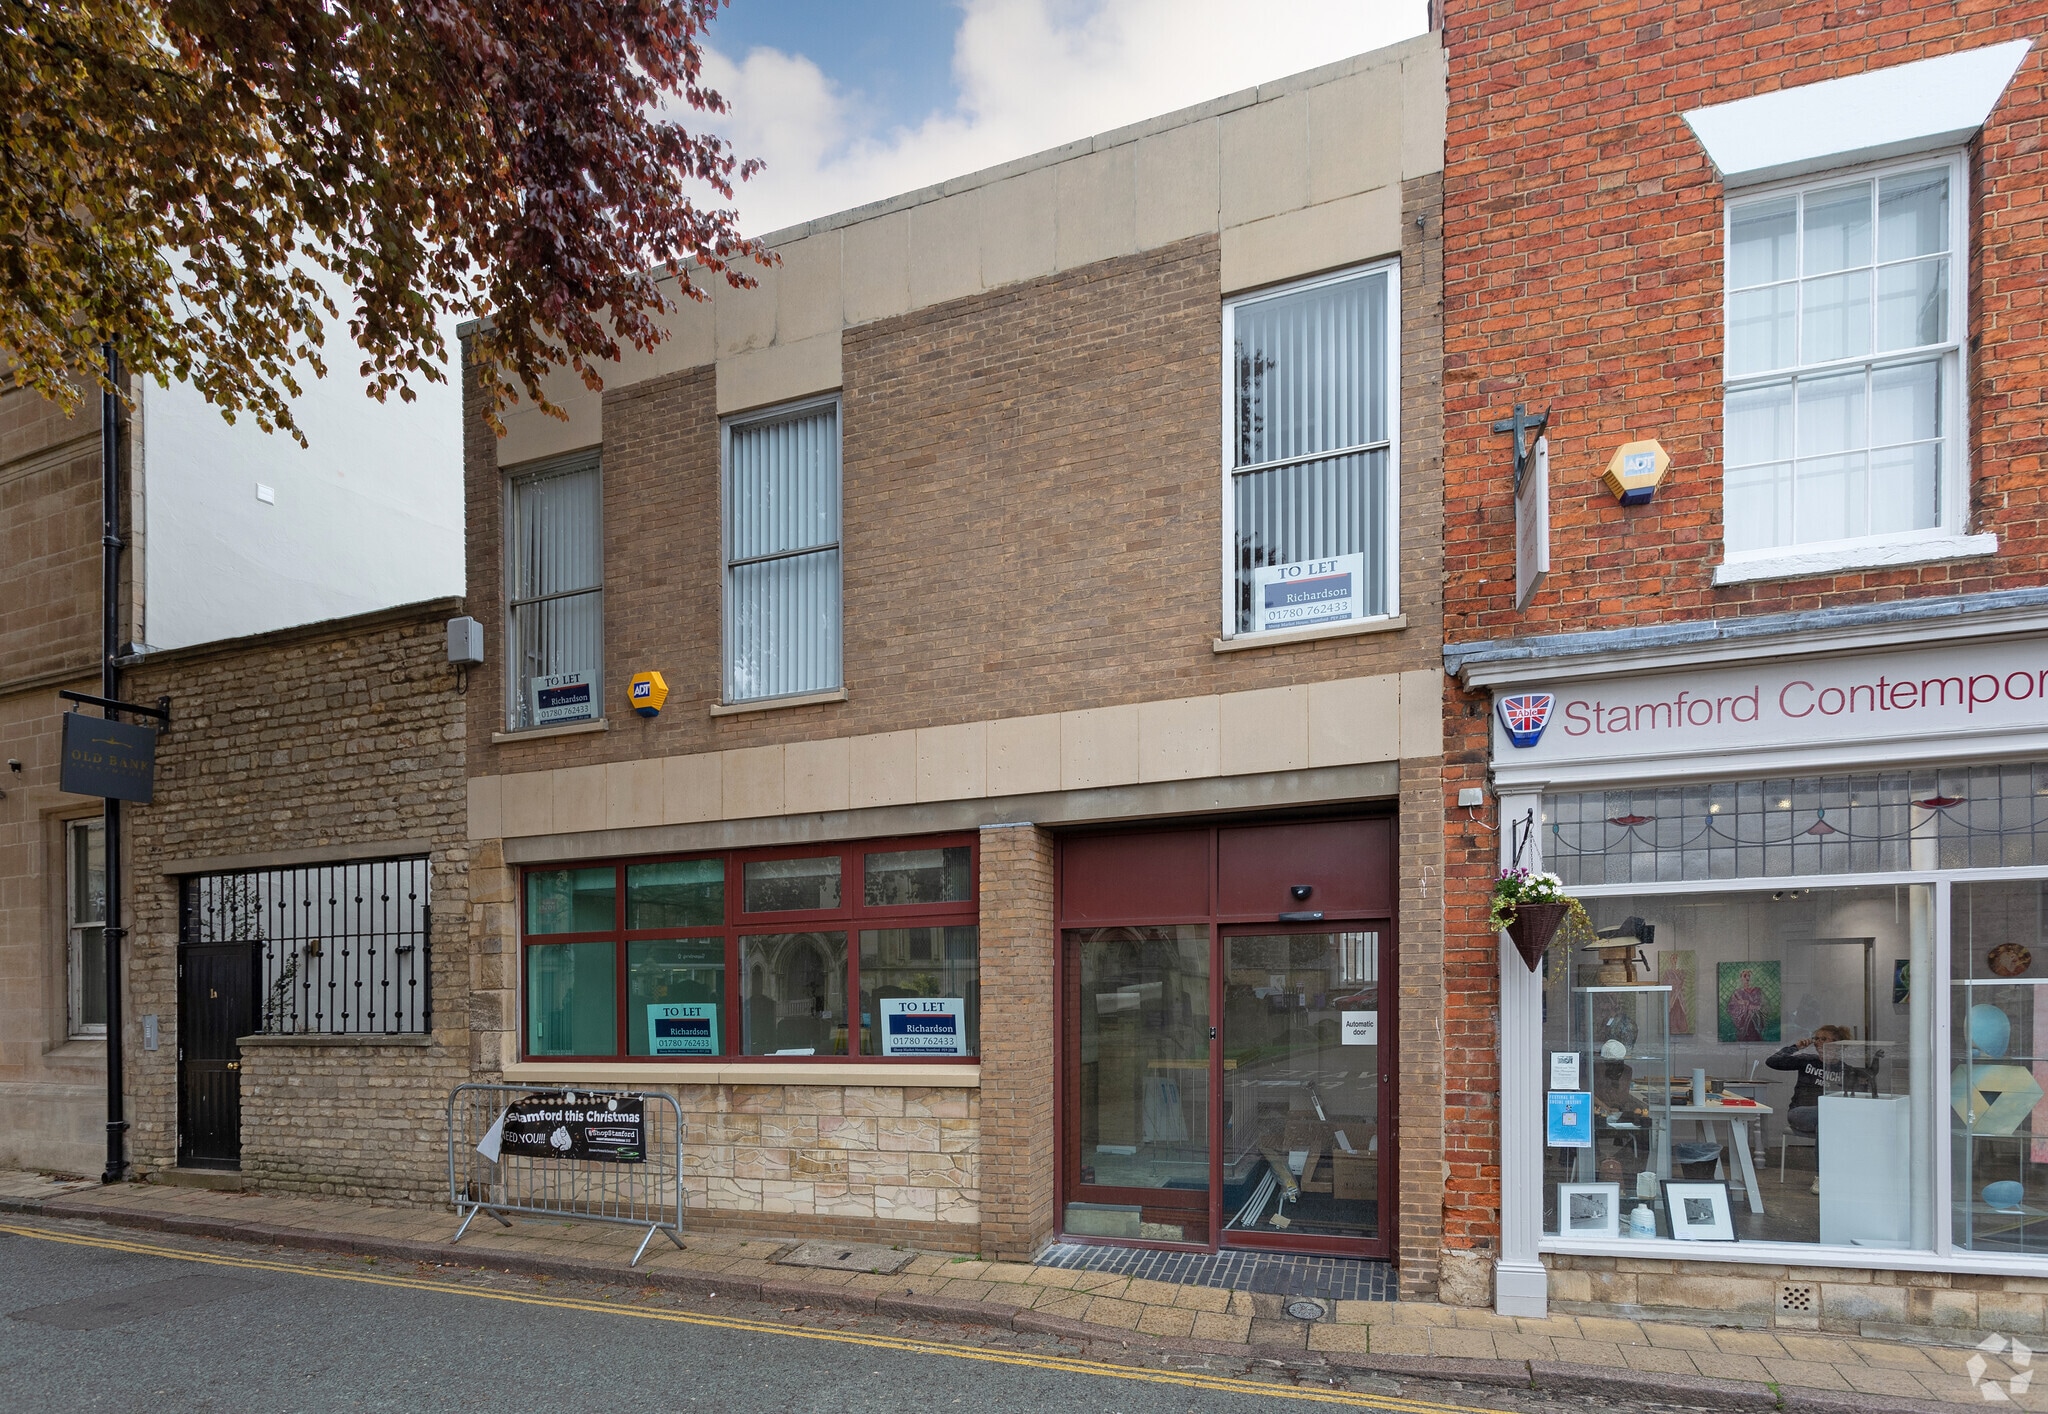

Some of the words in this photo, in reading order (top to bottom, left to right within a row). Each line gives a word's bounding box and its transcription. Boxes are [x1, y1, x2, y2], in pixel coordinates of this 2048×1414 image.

[1625, 455, 1655, 471] ADT
[1278, 566, 1301, 579] TO
[1308, 560, 1338, 575] LET
[1287, 588, 1347, 603] Richardson
[1268, 607, 1303, 621] 01780
[1307, 601, 1348, 616] 762433
[545, 677, 559, 687] TO
[563, 673, 581, 685] LET
[634, 683, 650, 697] ADT
[551, 694, 588, 706] Richardson
[1563, 685, 1759, 737] Stamford
[1778, 669, 2048, 718] Contempor
[541, 708, 562, 719] 01780
[565, 704, 589, 715] 762433
[1518, 709, 1538, 717] Able
[72, 750, 102, 763] OLD
[109, 755, 149, 771] BANK
[663, 1007, 679, 1016] TO
[683, 1007, 701, 1016] LET
[899, 1001, 917, 1012] TO
[922, 1001, 945, 1012] LET
[670, 1027, 709, 1036] Richardson
[907, 1024, 954, 1033] Richardson
[658, 1039, 682, 1047] 01780
[684, 1039, 709, 1047] 762433
[893, 1037, 920, 1045] 01780
[923, 1037, 954, 1045] 762433
[1805, 1063, 1842, 1081] GIVENCH
[565, 1110, 584, 1122] this
[586, 1111, 640, 1123] Christmas
[518, 1132, 546, 1144] YOU!!!
